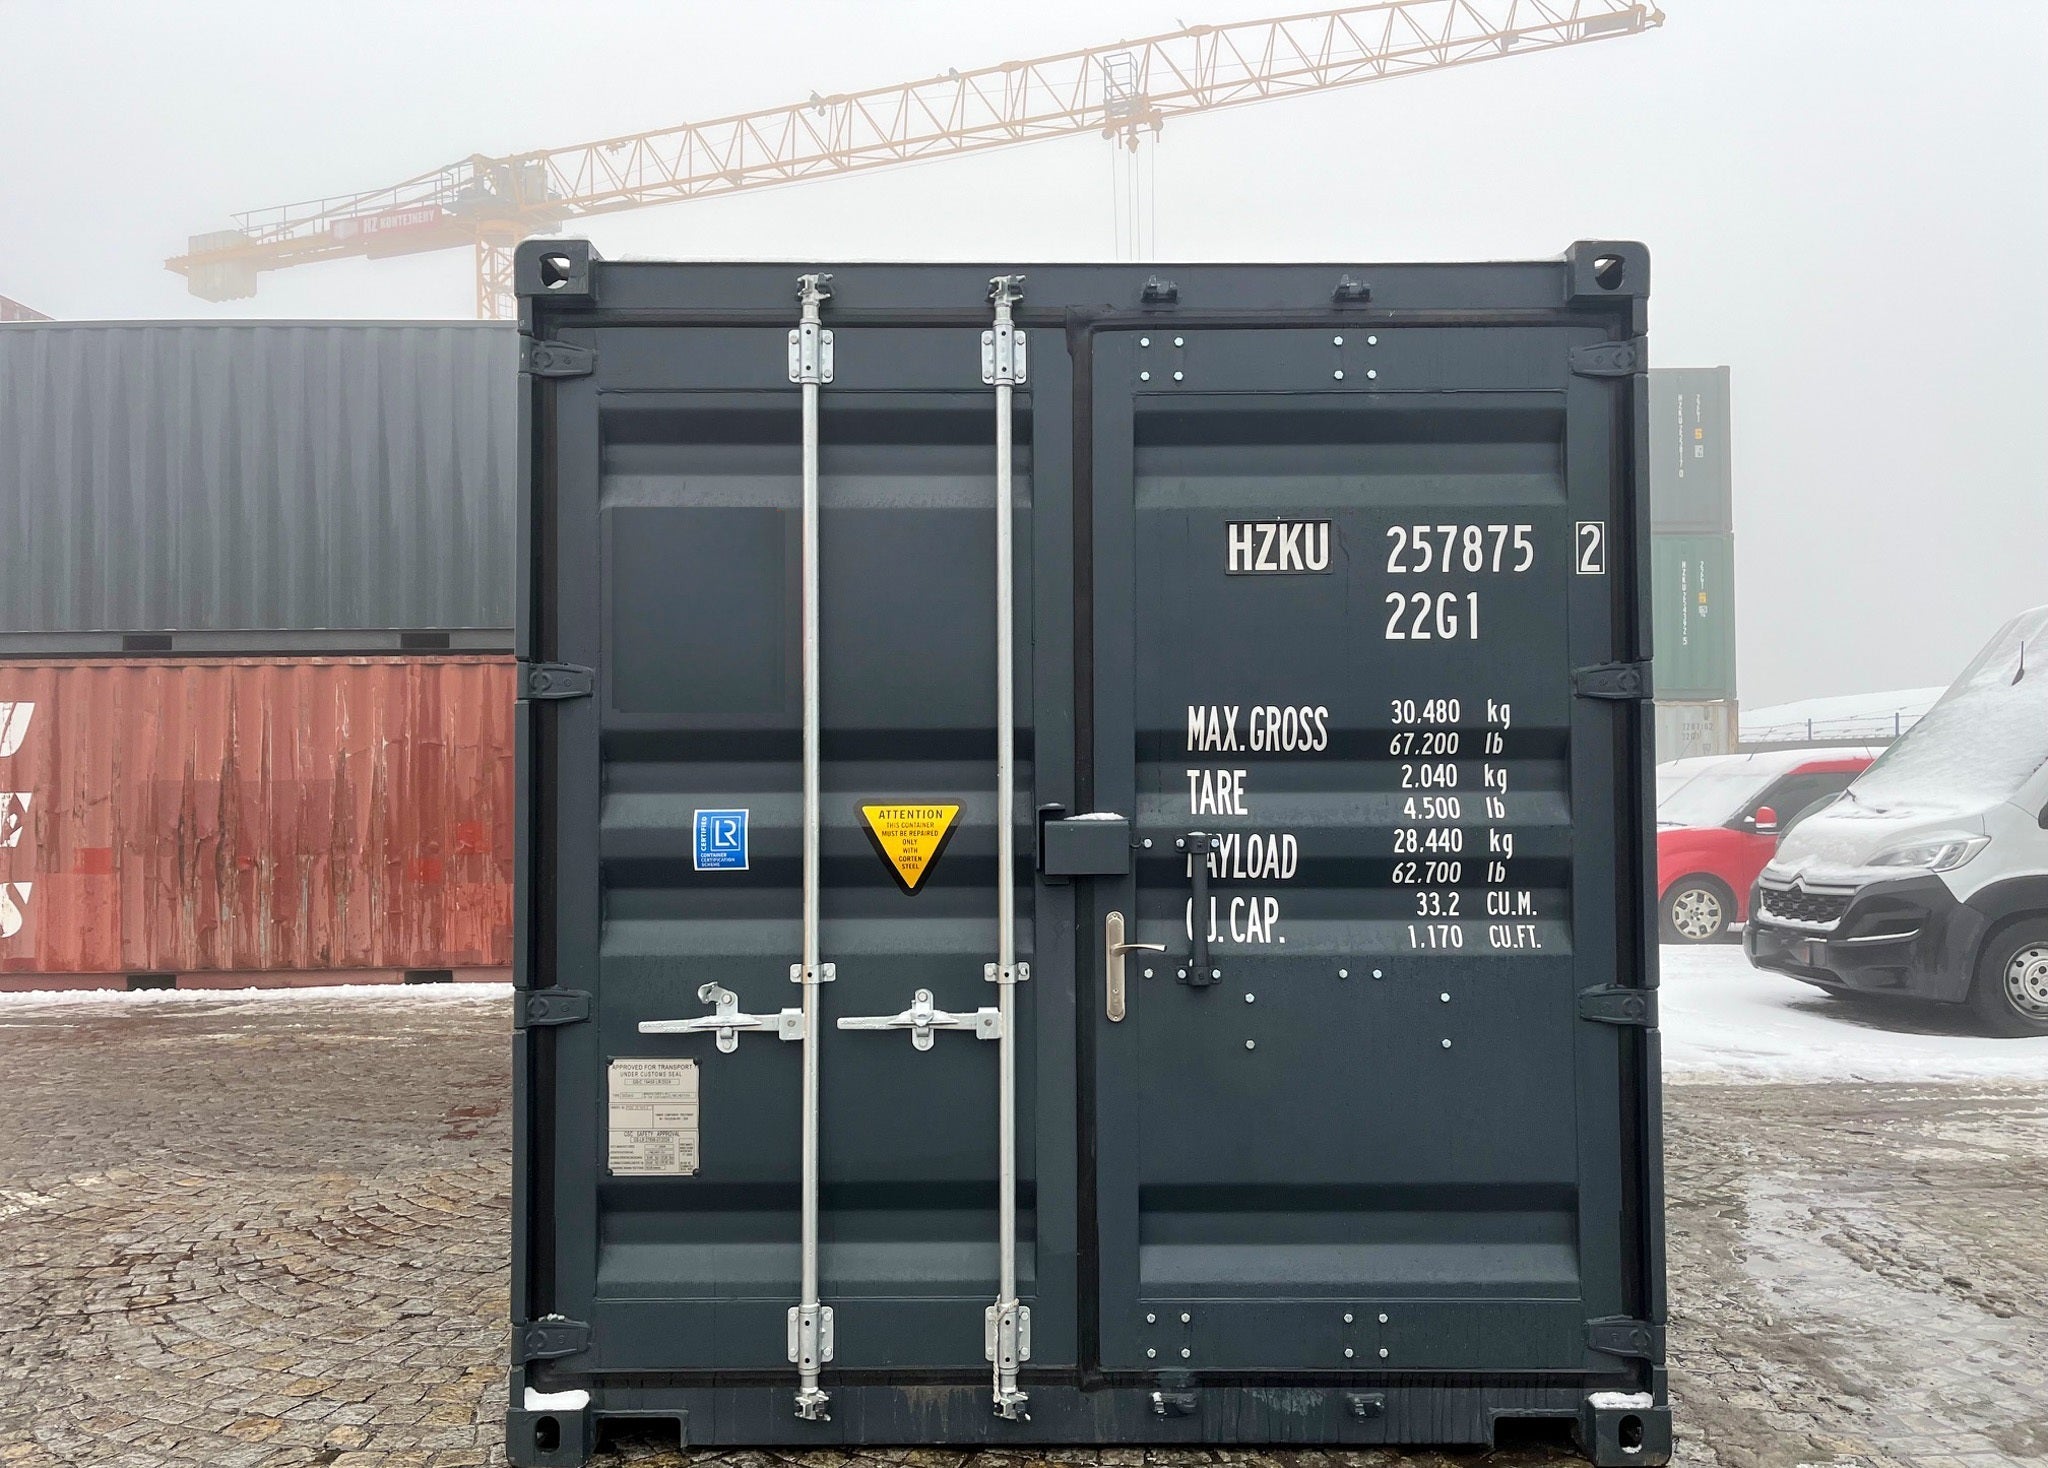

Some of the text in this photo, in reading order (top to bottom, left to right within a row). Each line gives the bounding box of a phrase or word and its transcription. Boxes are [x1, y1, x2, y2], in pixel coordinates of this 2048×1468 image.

[1228, 523, 1602, 573] HZKU 257875 2
[1385, 592, 1478, 639] 22G1
[1391, 699, 1461, 724] 30,480
[1487, 698, 1511, 730] kg
[1389, 731, 1504, 756] 67,200 lb
[1186, 763, 1508, 816] TARE 2,040 kg
[878, 809, 944, 820] ATTENTION
[1485, 796, 1506, 819] lb
[715, 819, 738, 847] LR
[902, 838, 918, 846] ONLY
[1393, 827, 1463, 853] 28,440
[1489, 827, 1514, 860] kg
[1391, 860, 1506, 884] 62,700 lb
[1415, 891, 1460, 917] 33.2
